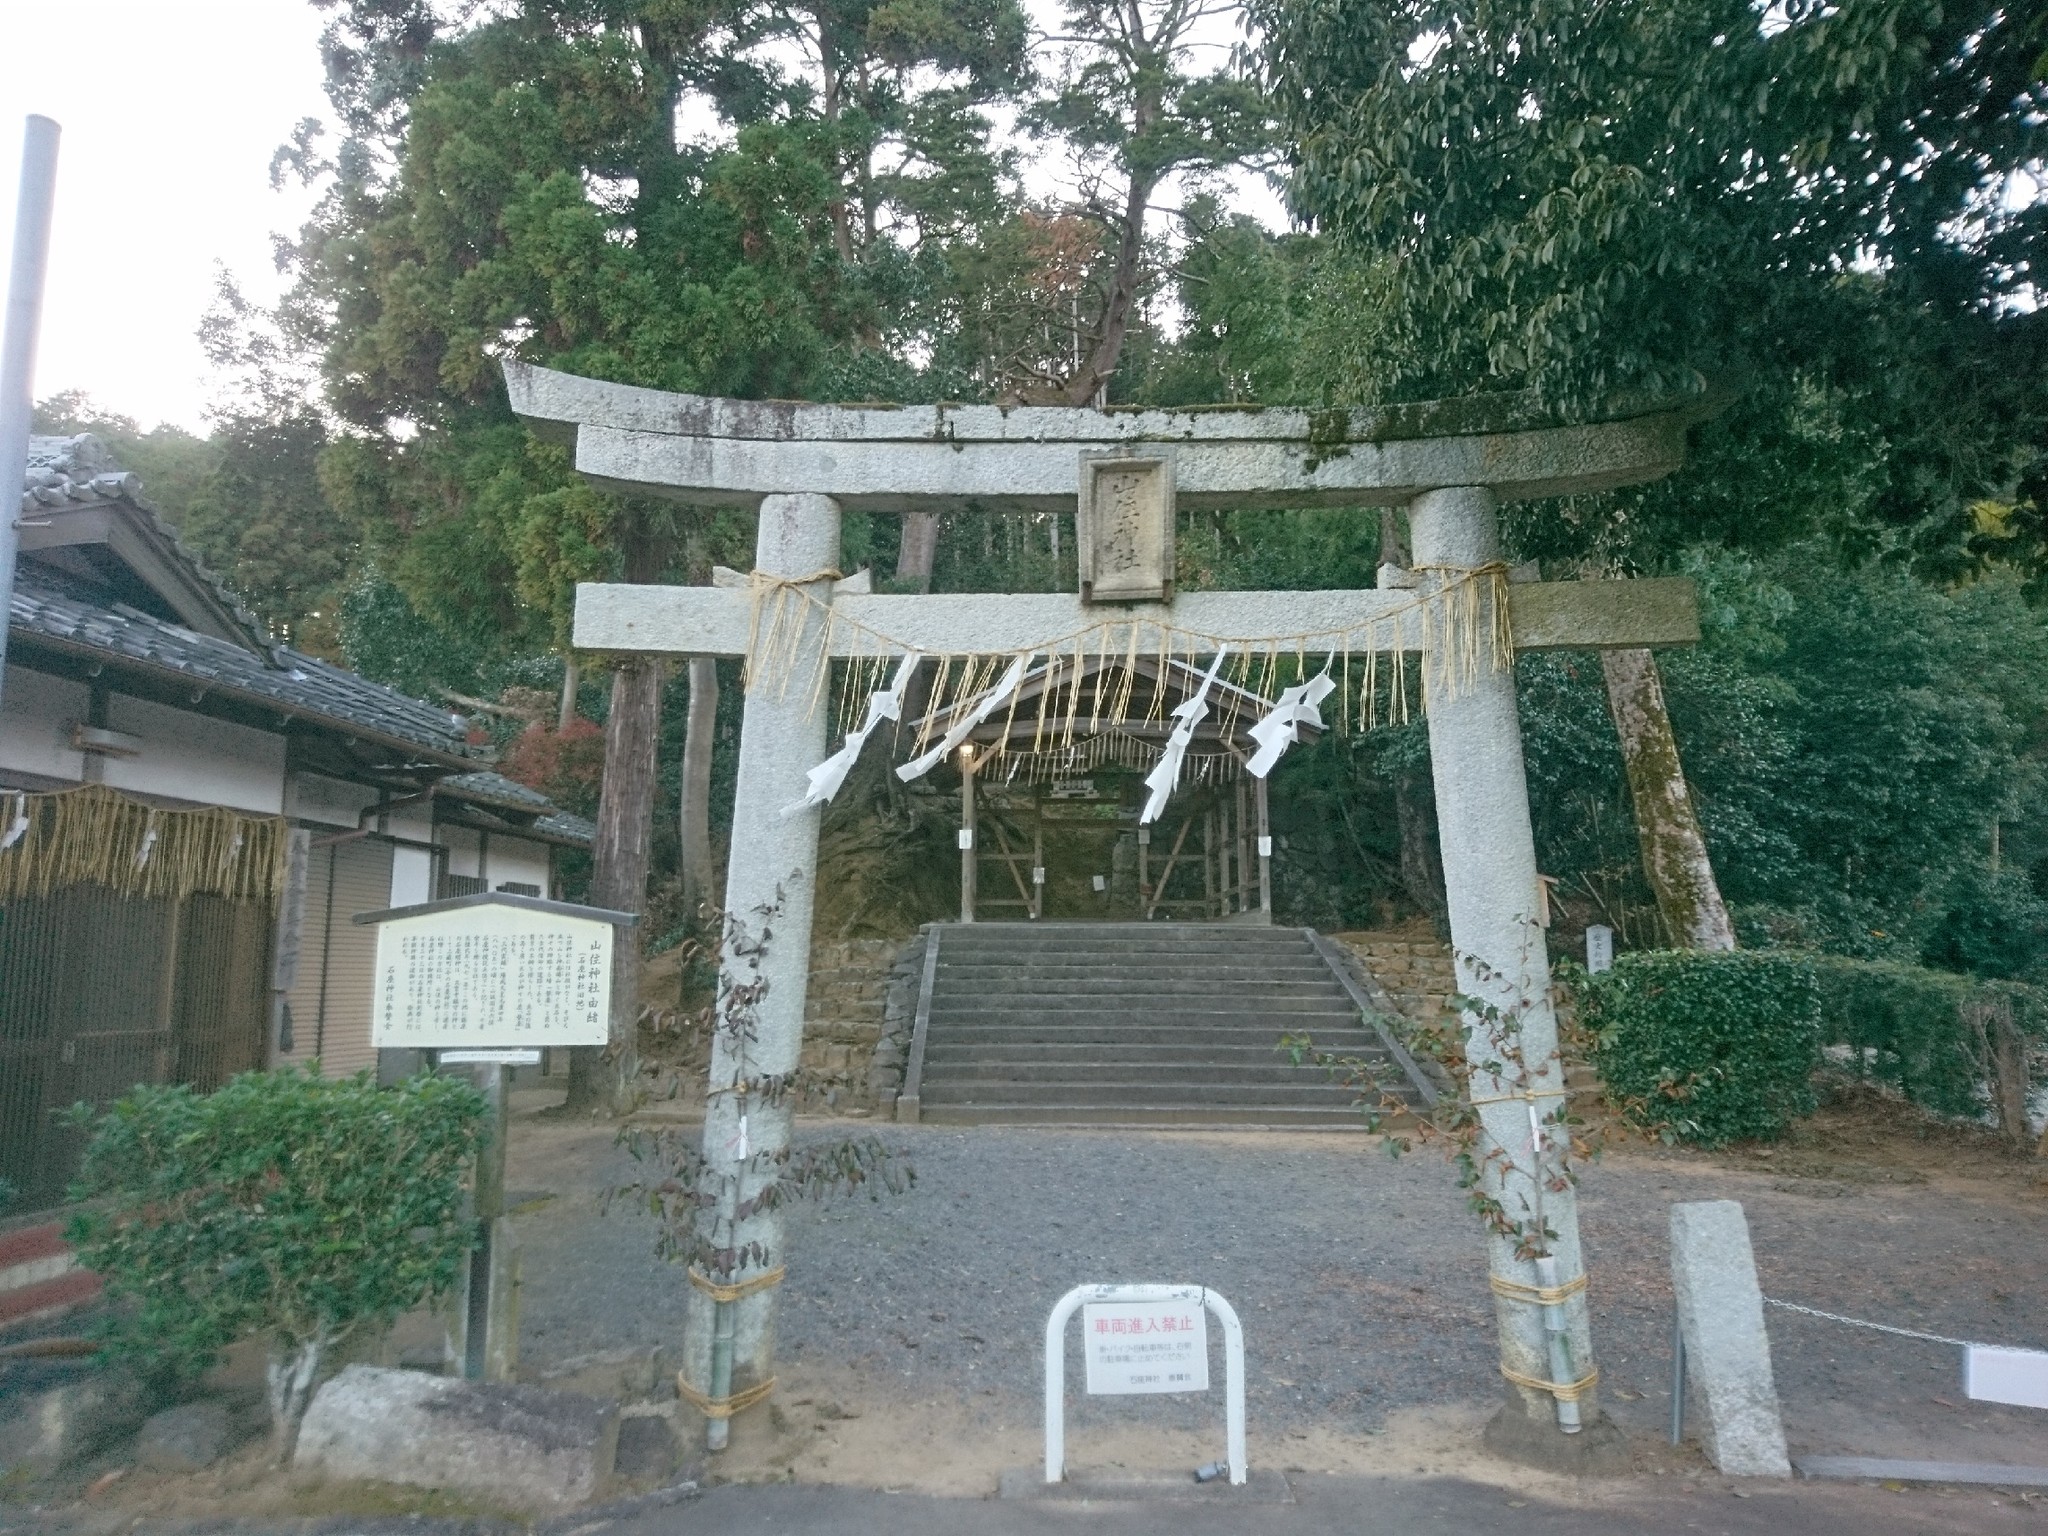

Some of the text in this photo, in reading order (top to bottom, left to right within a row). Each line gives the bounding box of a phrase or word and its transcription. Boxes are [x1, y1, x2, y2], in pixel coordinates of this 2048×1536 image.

[586, 940, 602, 1024] 山住神社由緒
[1094, 1314, 1194, 1335] 車両進入禁止
